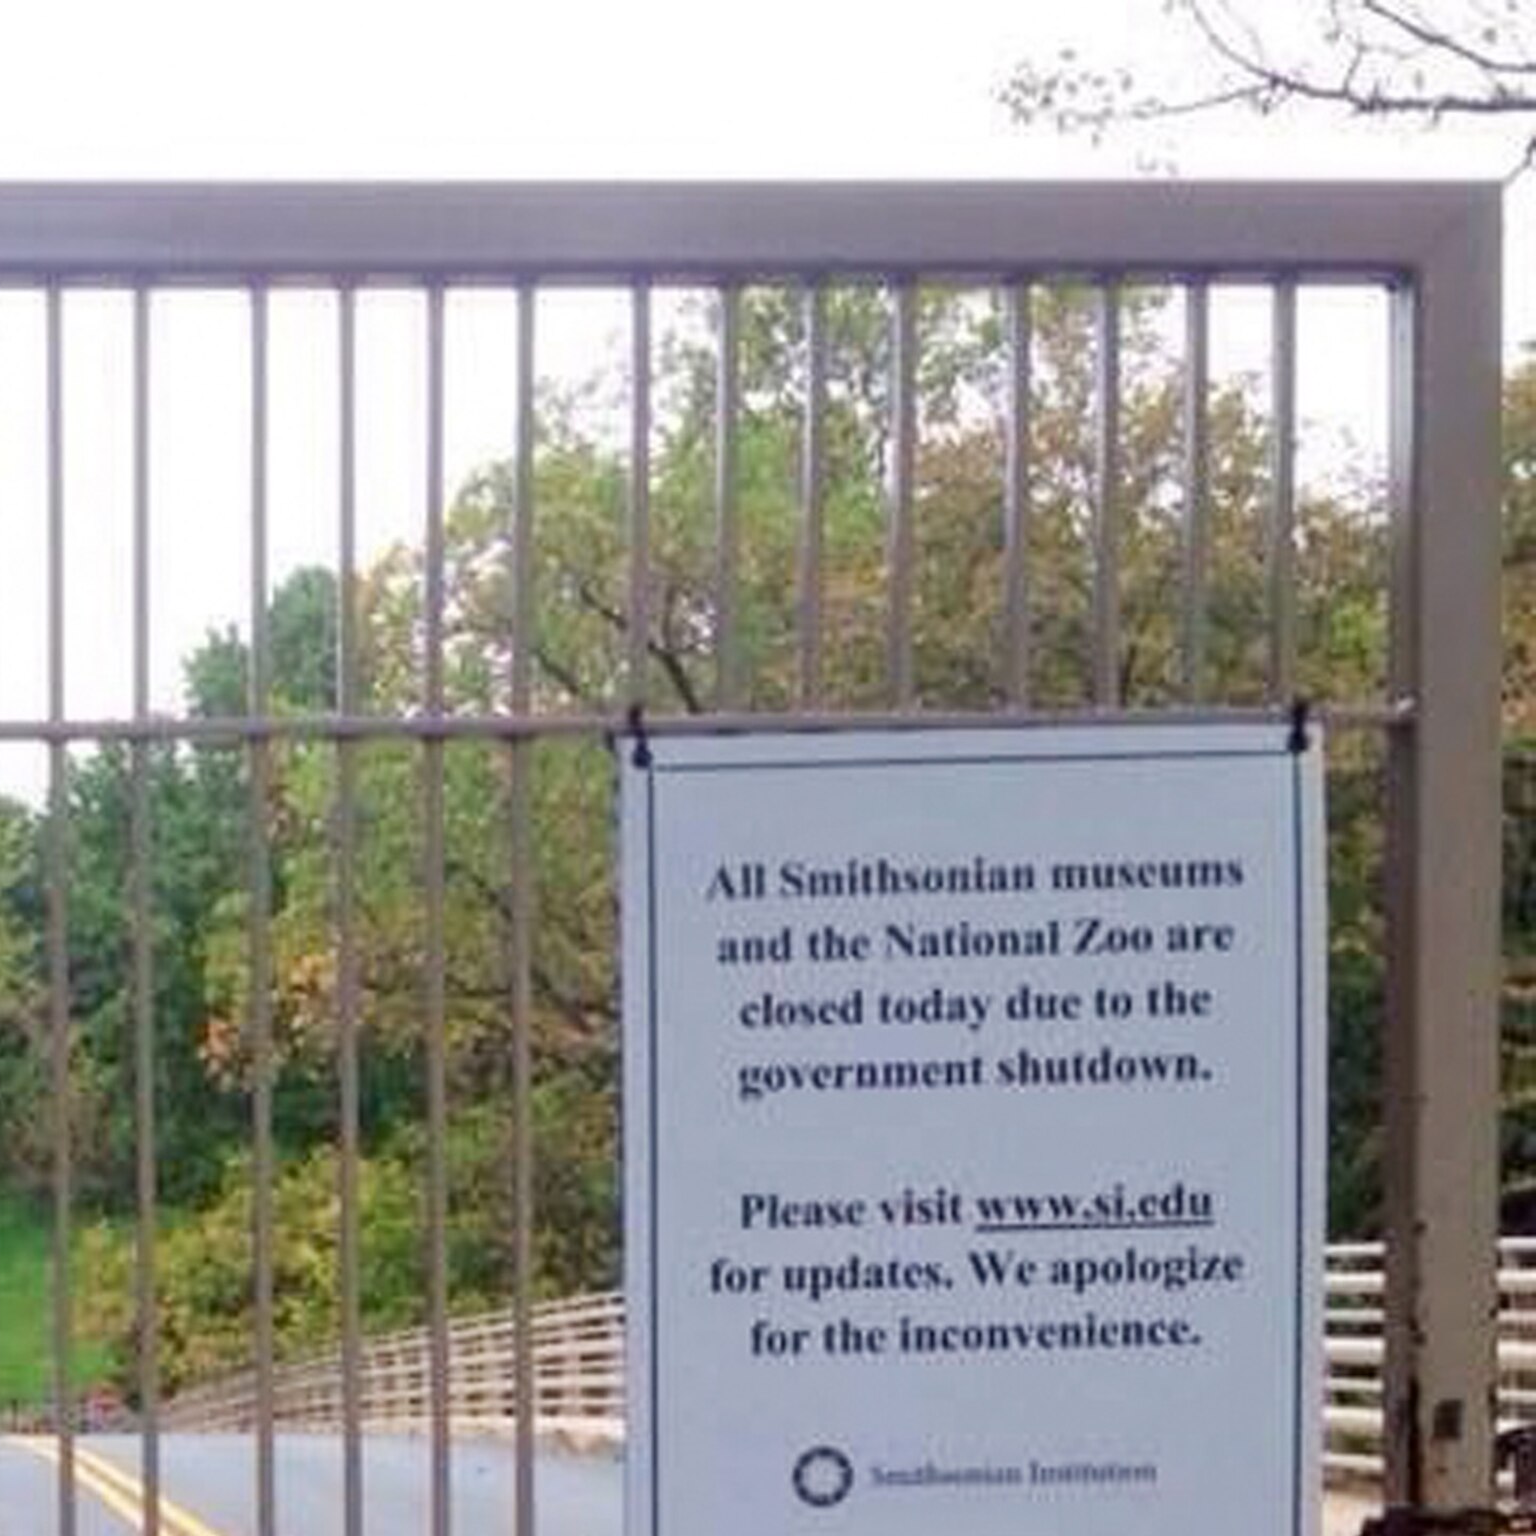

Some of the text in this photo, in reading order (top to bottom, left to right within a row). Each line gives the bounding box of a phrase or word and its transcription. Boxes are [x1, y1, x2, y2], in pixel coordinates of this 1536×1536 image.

[709, 857, 1244, 899] All Smithsonian museums
[718, 919, 1233, 964] and the National Zoo are
[740, 982, 1211, 1031] closed today due to the
[739, 1047, 1211, 1100] government shutdown.
[742, 1183, 1214, 1232] Please visit www.si.edu
[711, 1246, 1244, 1301] for updates. We apologize
[752, 1313, 1200, 1355] for the inconvenience.
